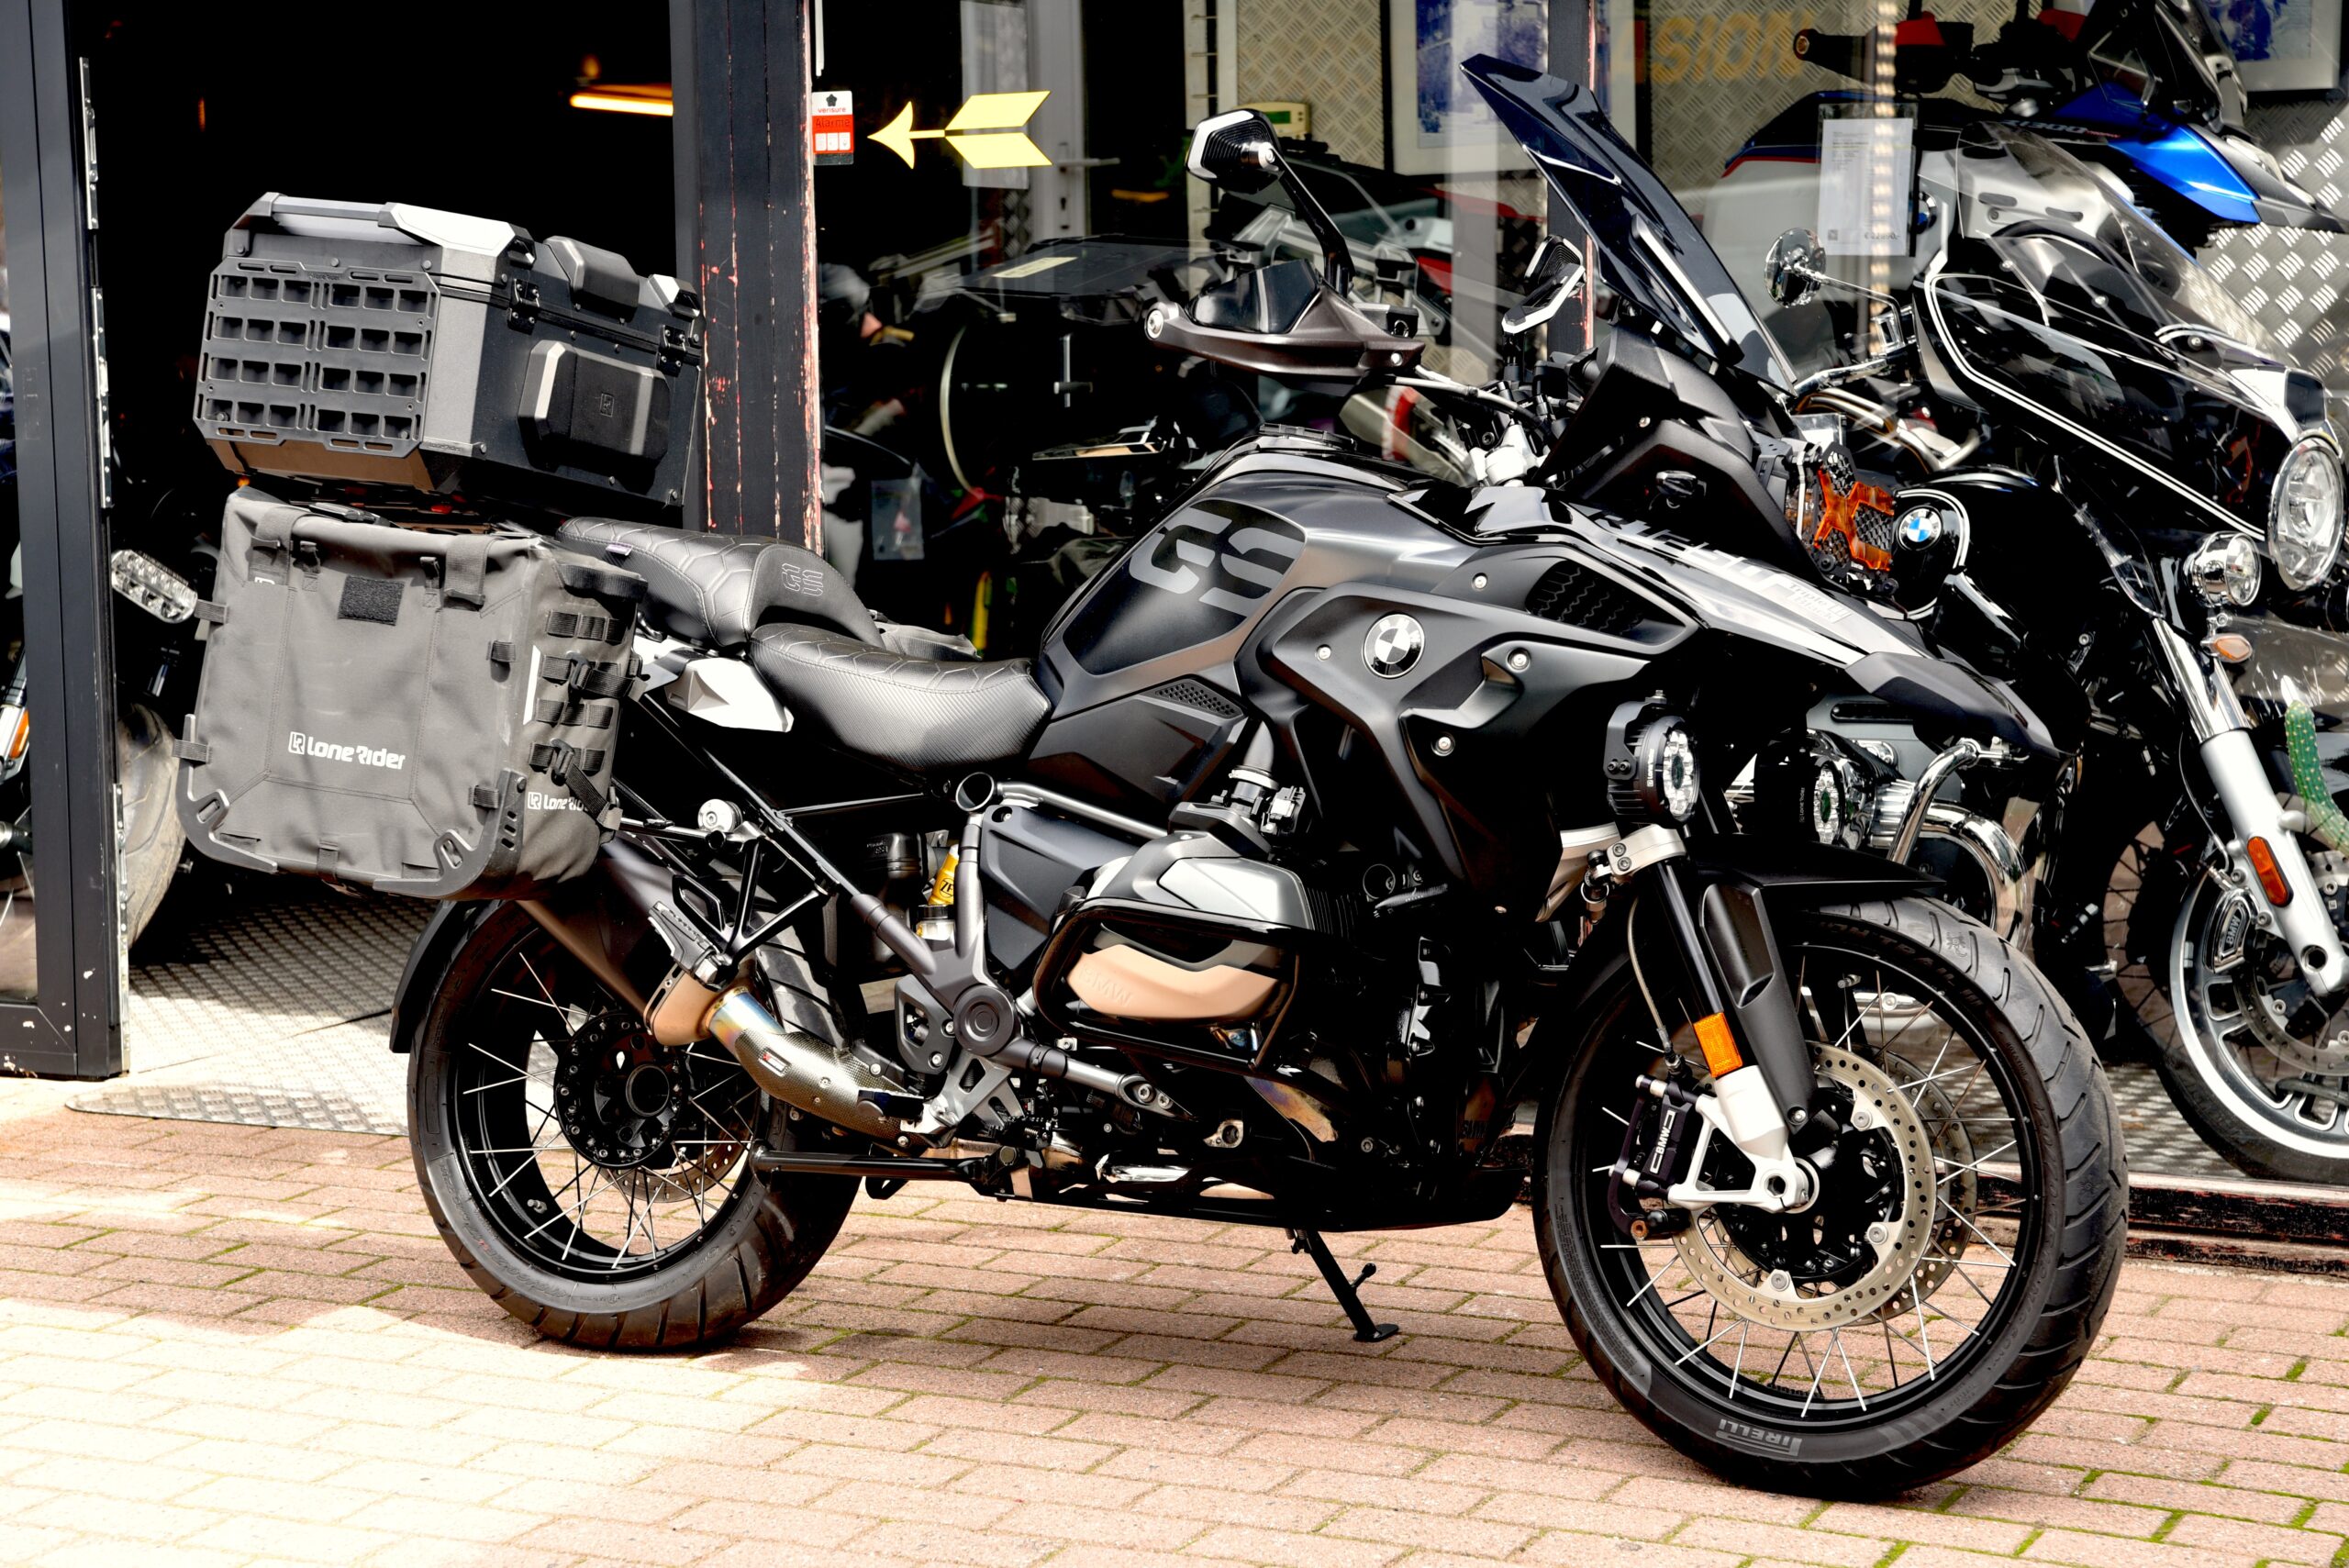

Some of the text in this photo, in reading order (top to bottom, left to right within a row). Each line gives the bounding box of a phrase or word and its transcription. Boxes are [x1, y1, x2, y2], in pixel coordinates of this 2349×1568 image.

[815, 117, 852, 128] Alarme
[1129, 506, 1305, 617] GS
[781, 562, 824, 597] GS
[306, 736, 355, 762] Lone
[355, 745, 406, 770] Rider
[543, 794, 569, 810] Lone
[2225, 914, 2242, 946] BMW
[1654, 1126, 1671, 1156] BMW
[1715, 1418, 1803, 1457] PIRELLI
